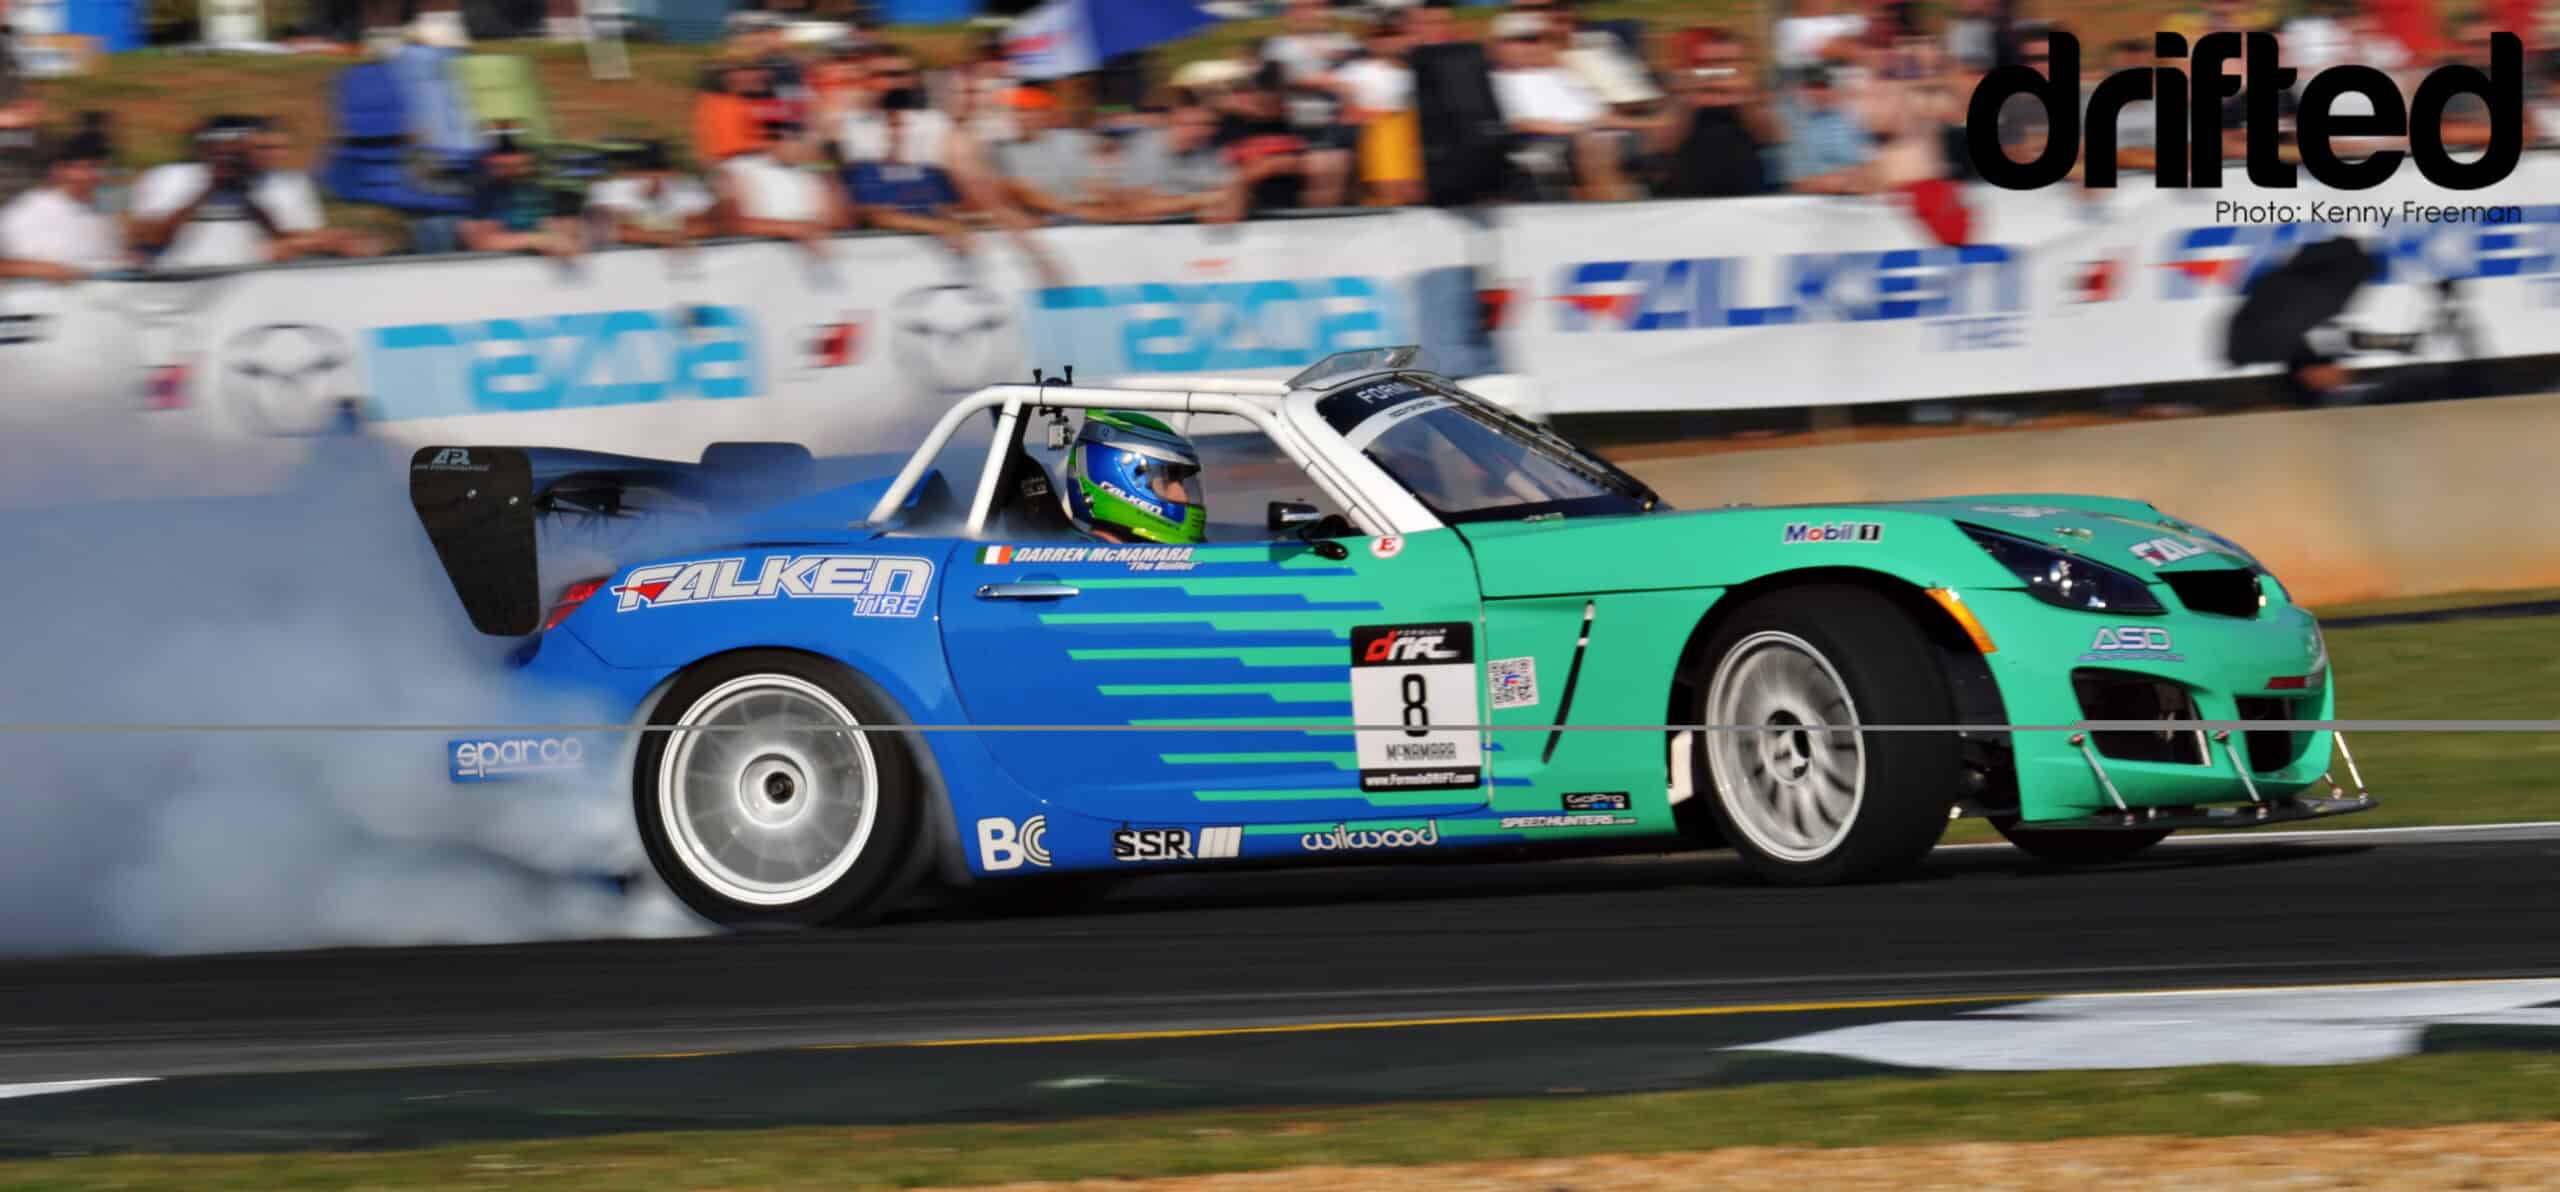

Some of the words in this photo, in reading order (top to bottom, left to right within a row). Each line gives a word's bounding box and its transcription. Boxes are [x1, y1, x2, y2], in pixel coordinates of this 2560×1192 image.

[1379, 537, 1396, 551] E
[1784, 523, 1855, 541] Mobil
[1861, 525, 1879, 540] 1
[1014, 547, 1088, 562] DARREN
[612, 555, 933, 612] FALKEN
[854, 594, 920, 617] TIRE
[1402, 674, 1429, 738] 8
[456, 738, 584, 778] sparco
[1112, 828, 1194, 861] SSR
[1302, 818, 1438, 850] wilwood
